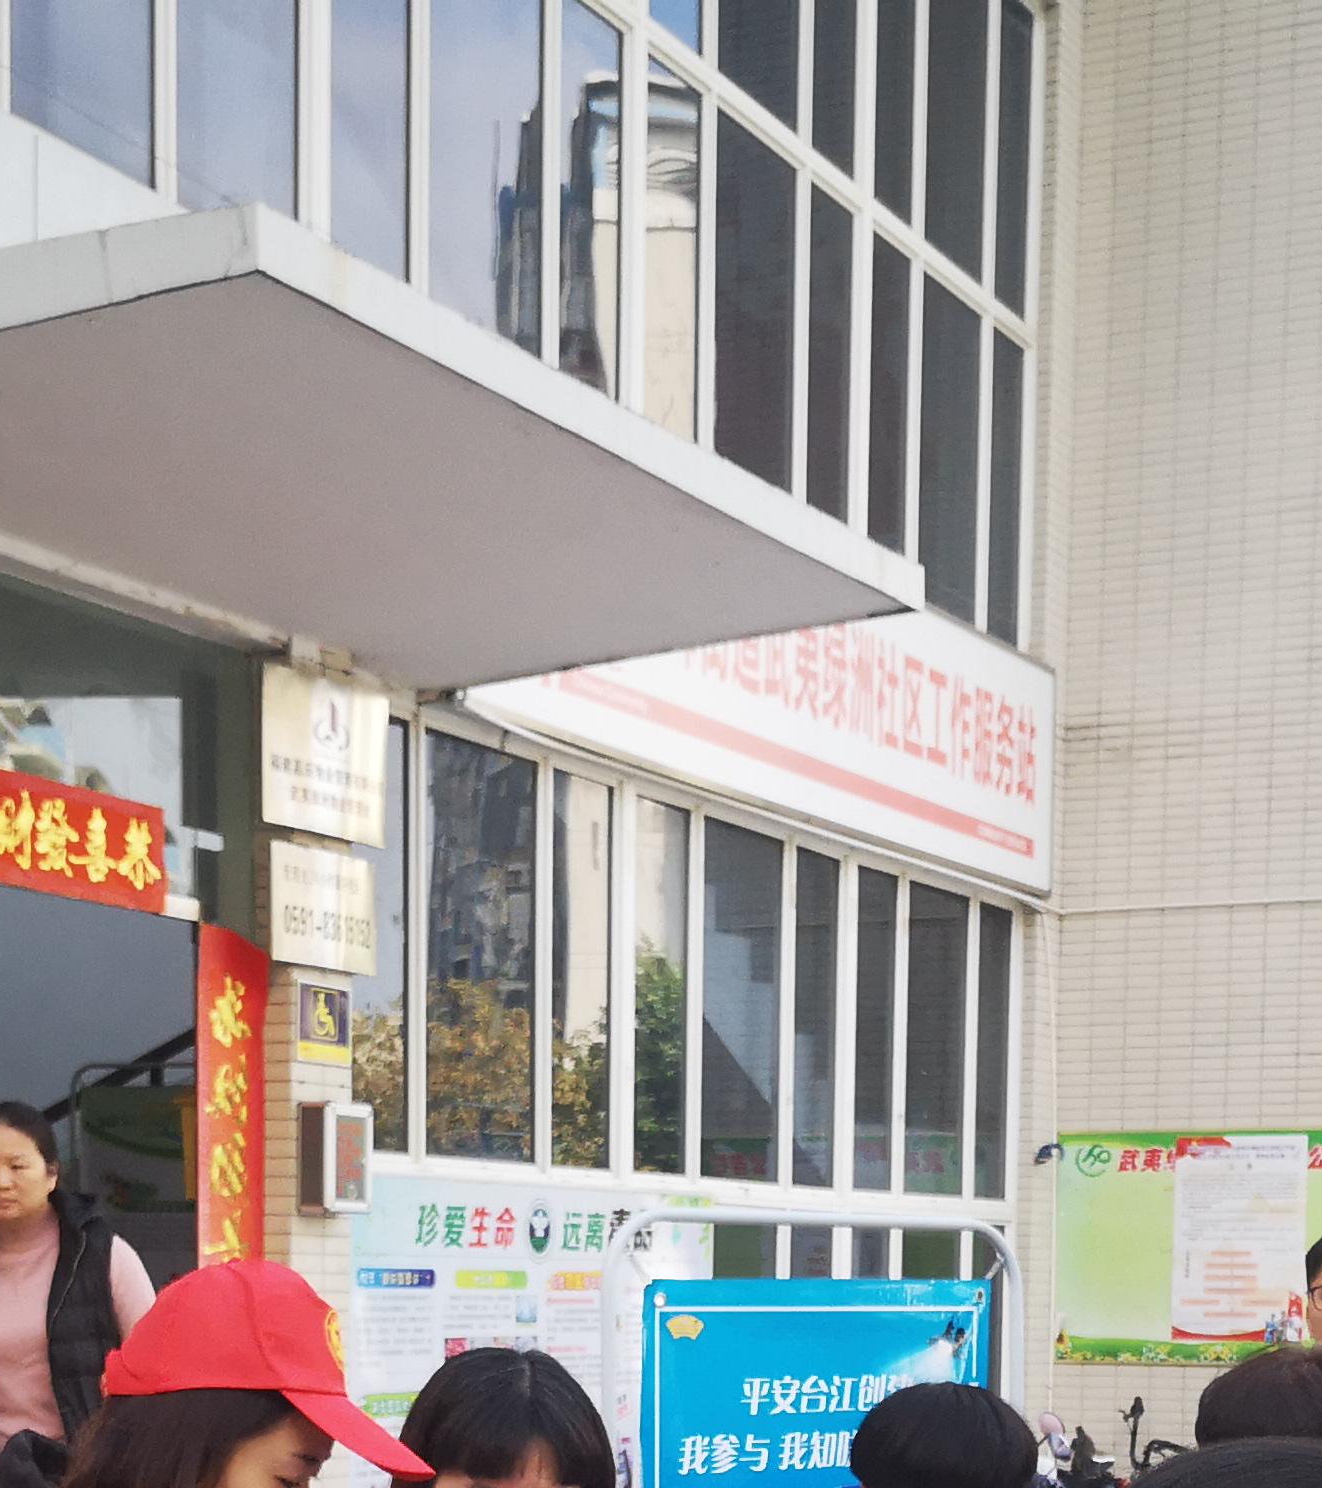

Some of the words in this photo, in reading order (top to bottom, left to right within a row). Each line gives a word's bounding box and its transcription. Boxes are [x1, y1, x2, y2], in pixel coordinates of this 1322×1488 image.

[414, 1202, 517, 1250] 珍爱生命
[740, 1373, 915, 1416] 平安台江创
[677, 1433, 771, 1476] 我参与
